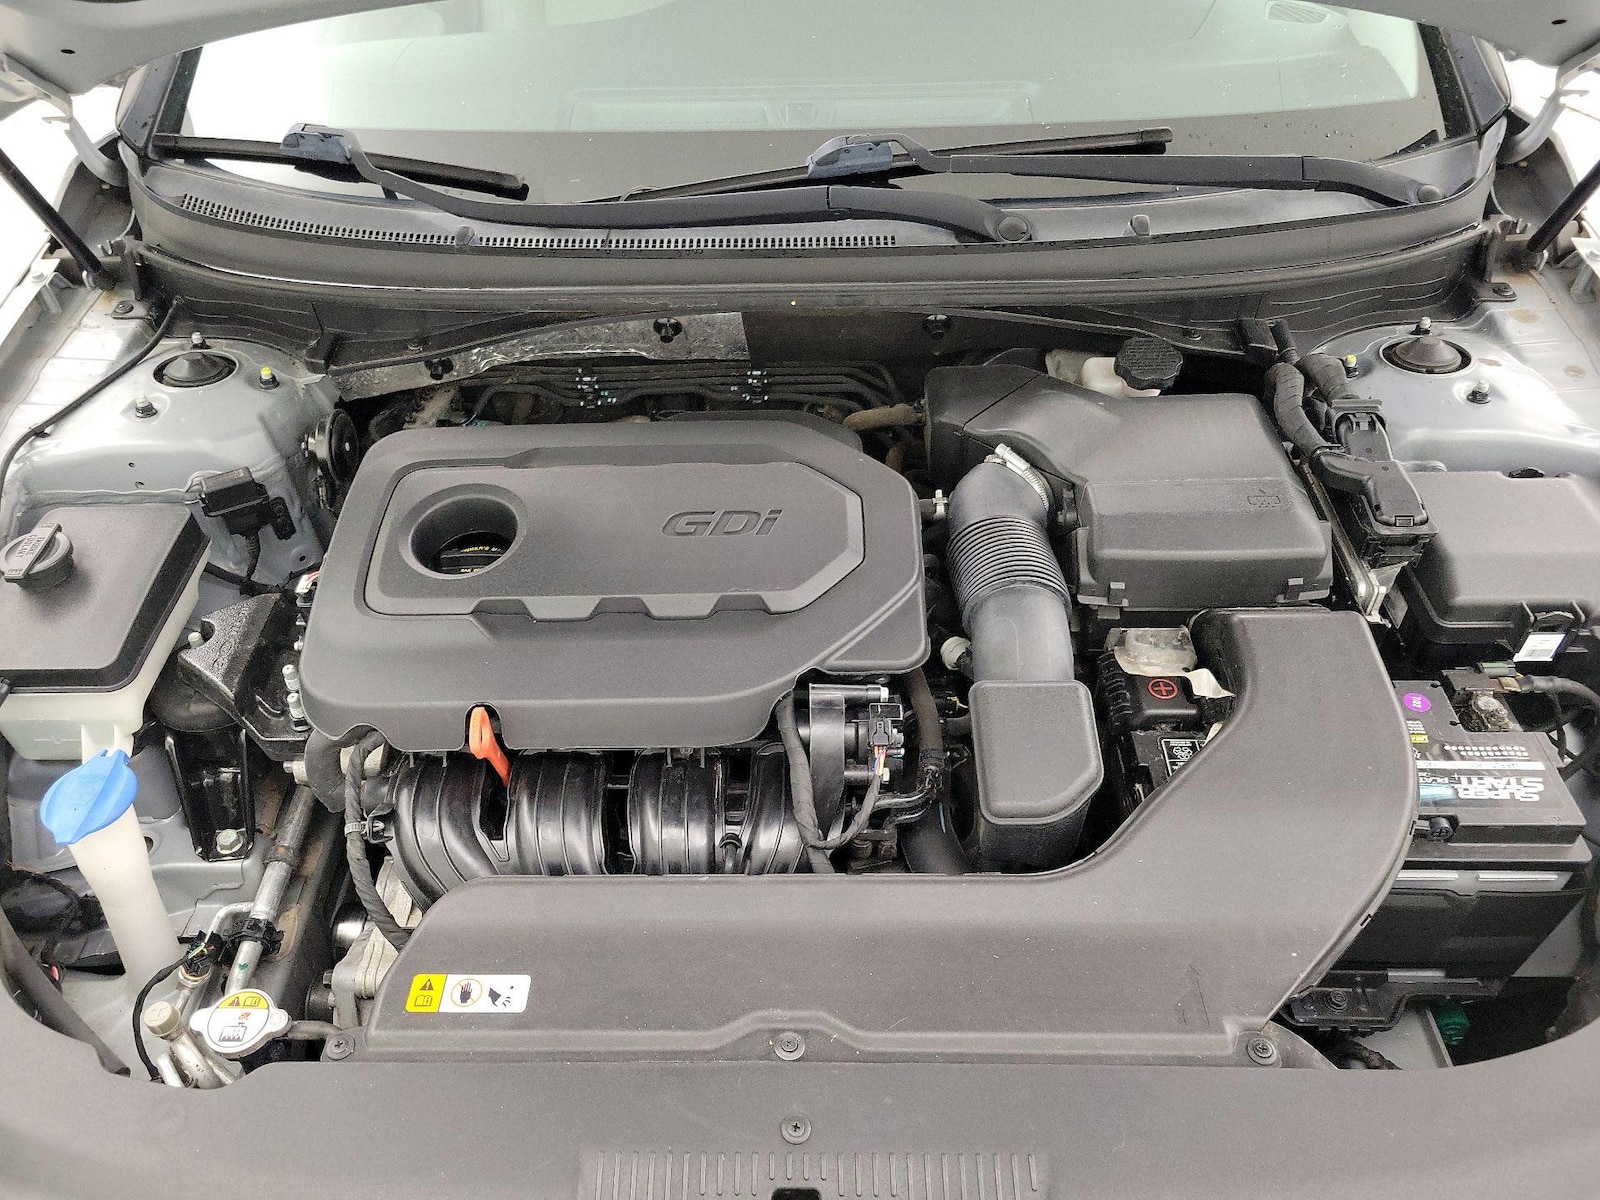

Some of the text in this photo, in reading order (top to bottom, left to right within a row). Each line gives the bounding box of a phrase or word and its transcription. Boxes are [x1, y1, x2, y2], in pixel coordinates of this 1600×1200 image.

[661, 509, 783, 537] GDi
[1452, 776, 1545, 792] START
[1457, 786, 1540, 801] SUPER
